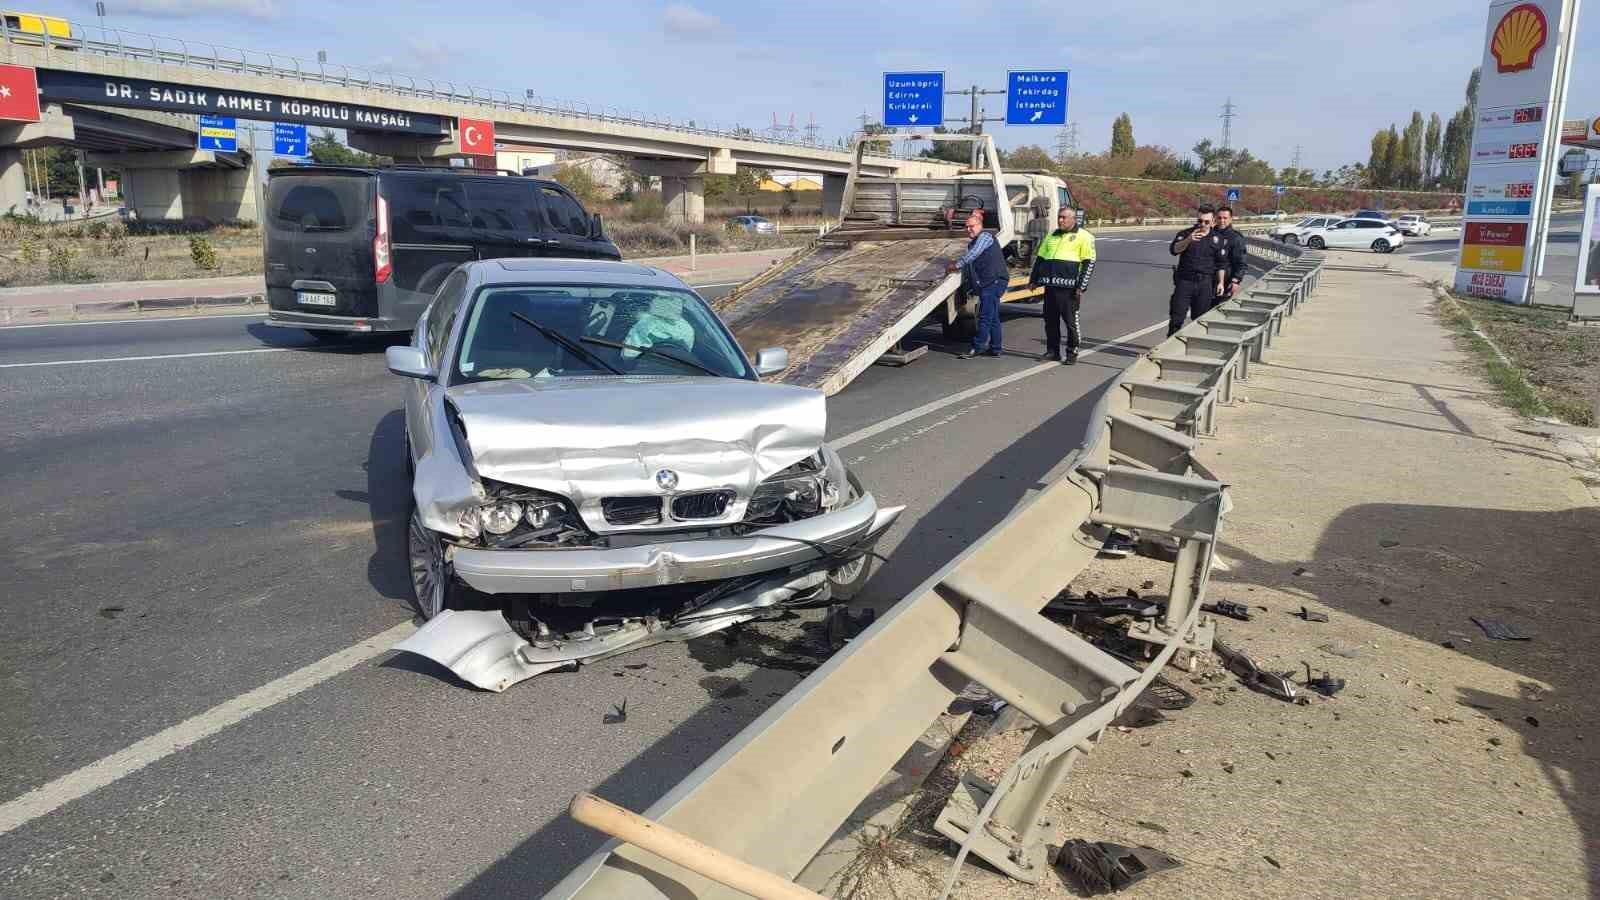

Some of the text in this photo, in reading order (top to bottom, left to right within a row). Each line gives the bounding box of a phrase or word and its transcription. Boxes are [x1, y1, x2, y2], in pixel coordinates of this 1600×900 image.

[105, 82, 140, 100] DR.
[149, 87, 208, 106] SADIK
[216, 94, 273, 113] AHMET
[281, 101, 349, 121] KÖPRÜLÜ
